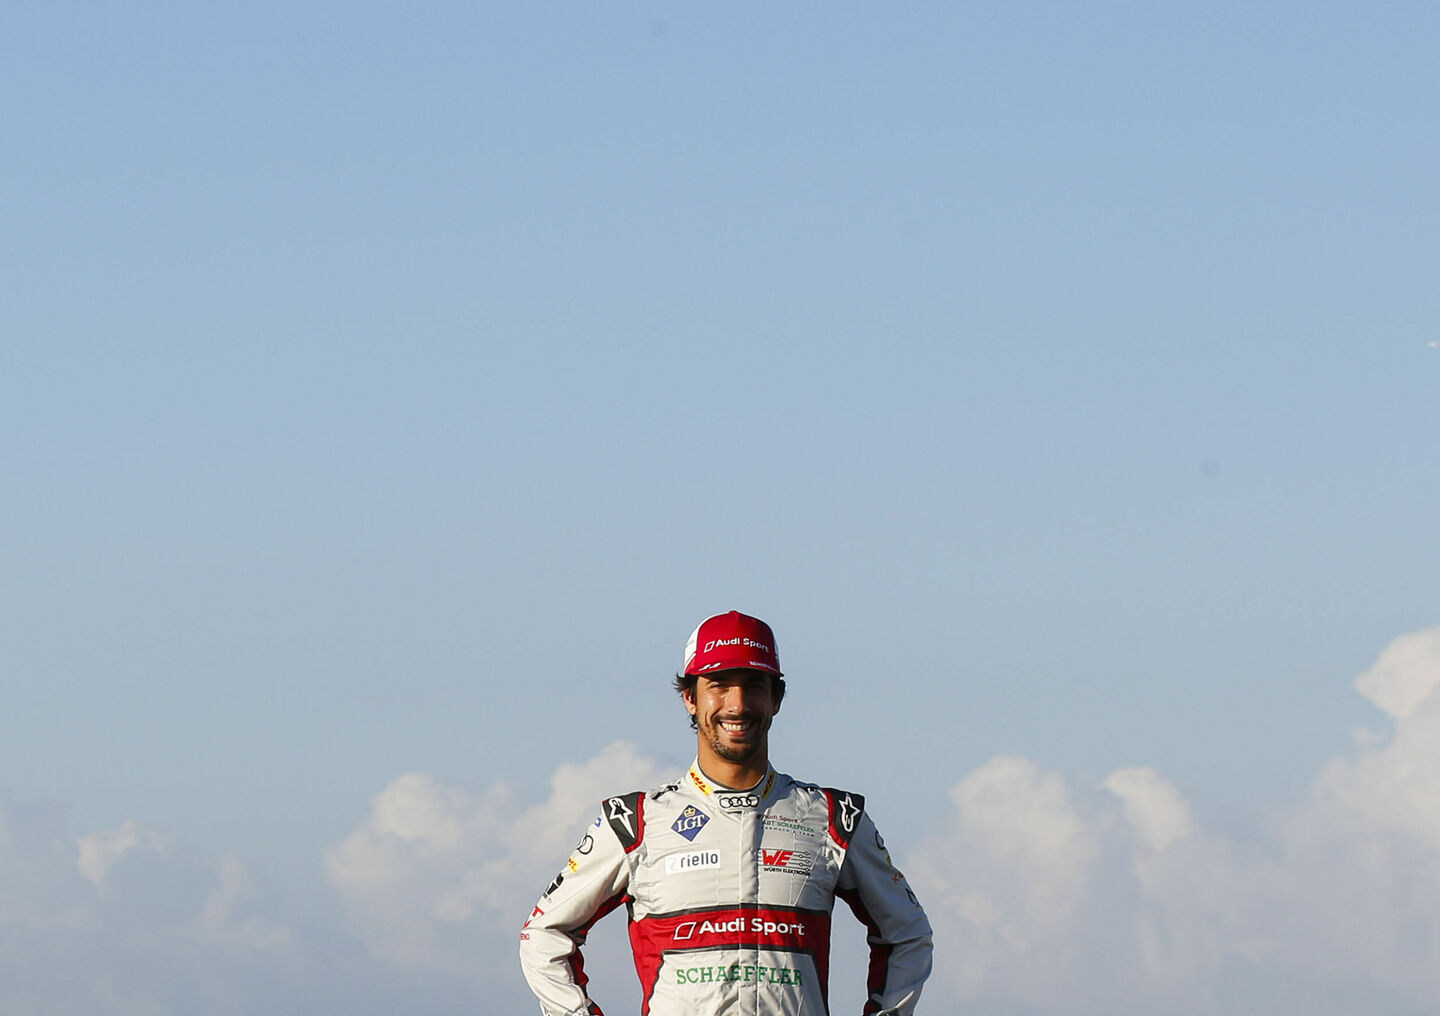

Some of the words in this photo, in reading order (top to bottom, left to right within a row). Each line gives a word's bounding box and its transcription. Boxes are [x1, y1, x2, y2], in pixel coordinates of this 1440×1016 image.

[715, 637, 741, 648] Audi
[743, 637, 769, 653] Sport
[676, 814, 706, 833] LGT
[680, 851, 719, 868] riello
[762, 849, 795, 867] WE
[698, 917, 746, 935] Audi
[750, 917, 806, 936] Sport
[676, 964, 803, 986] SCHAEFFLER
